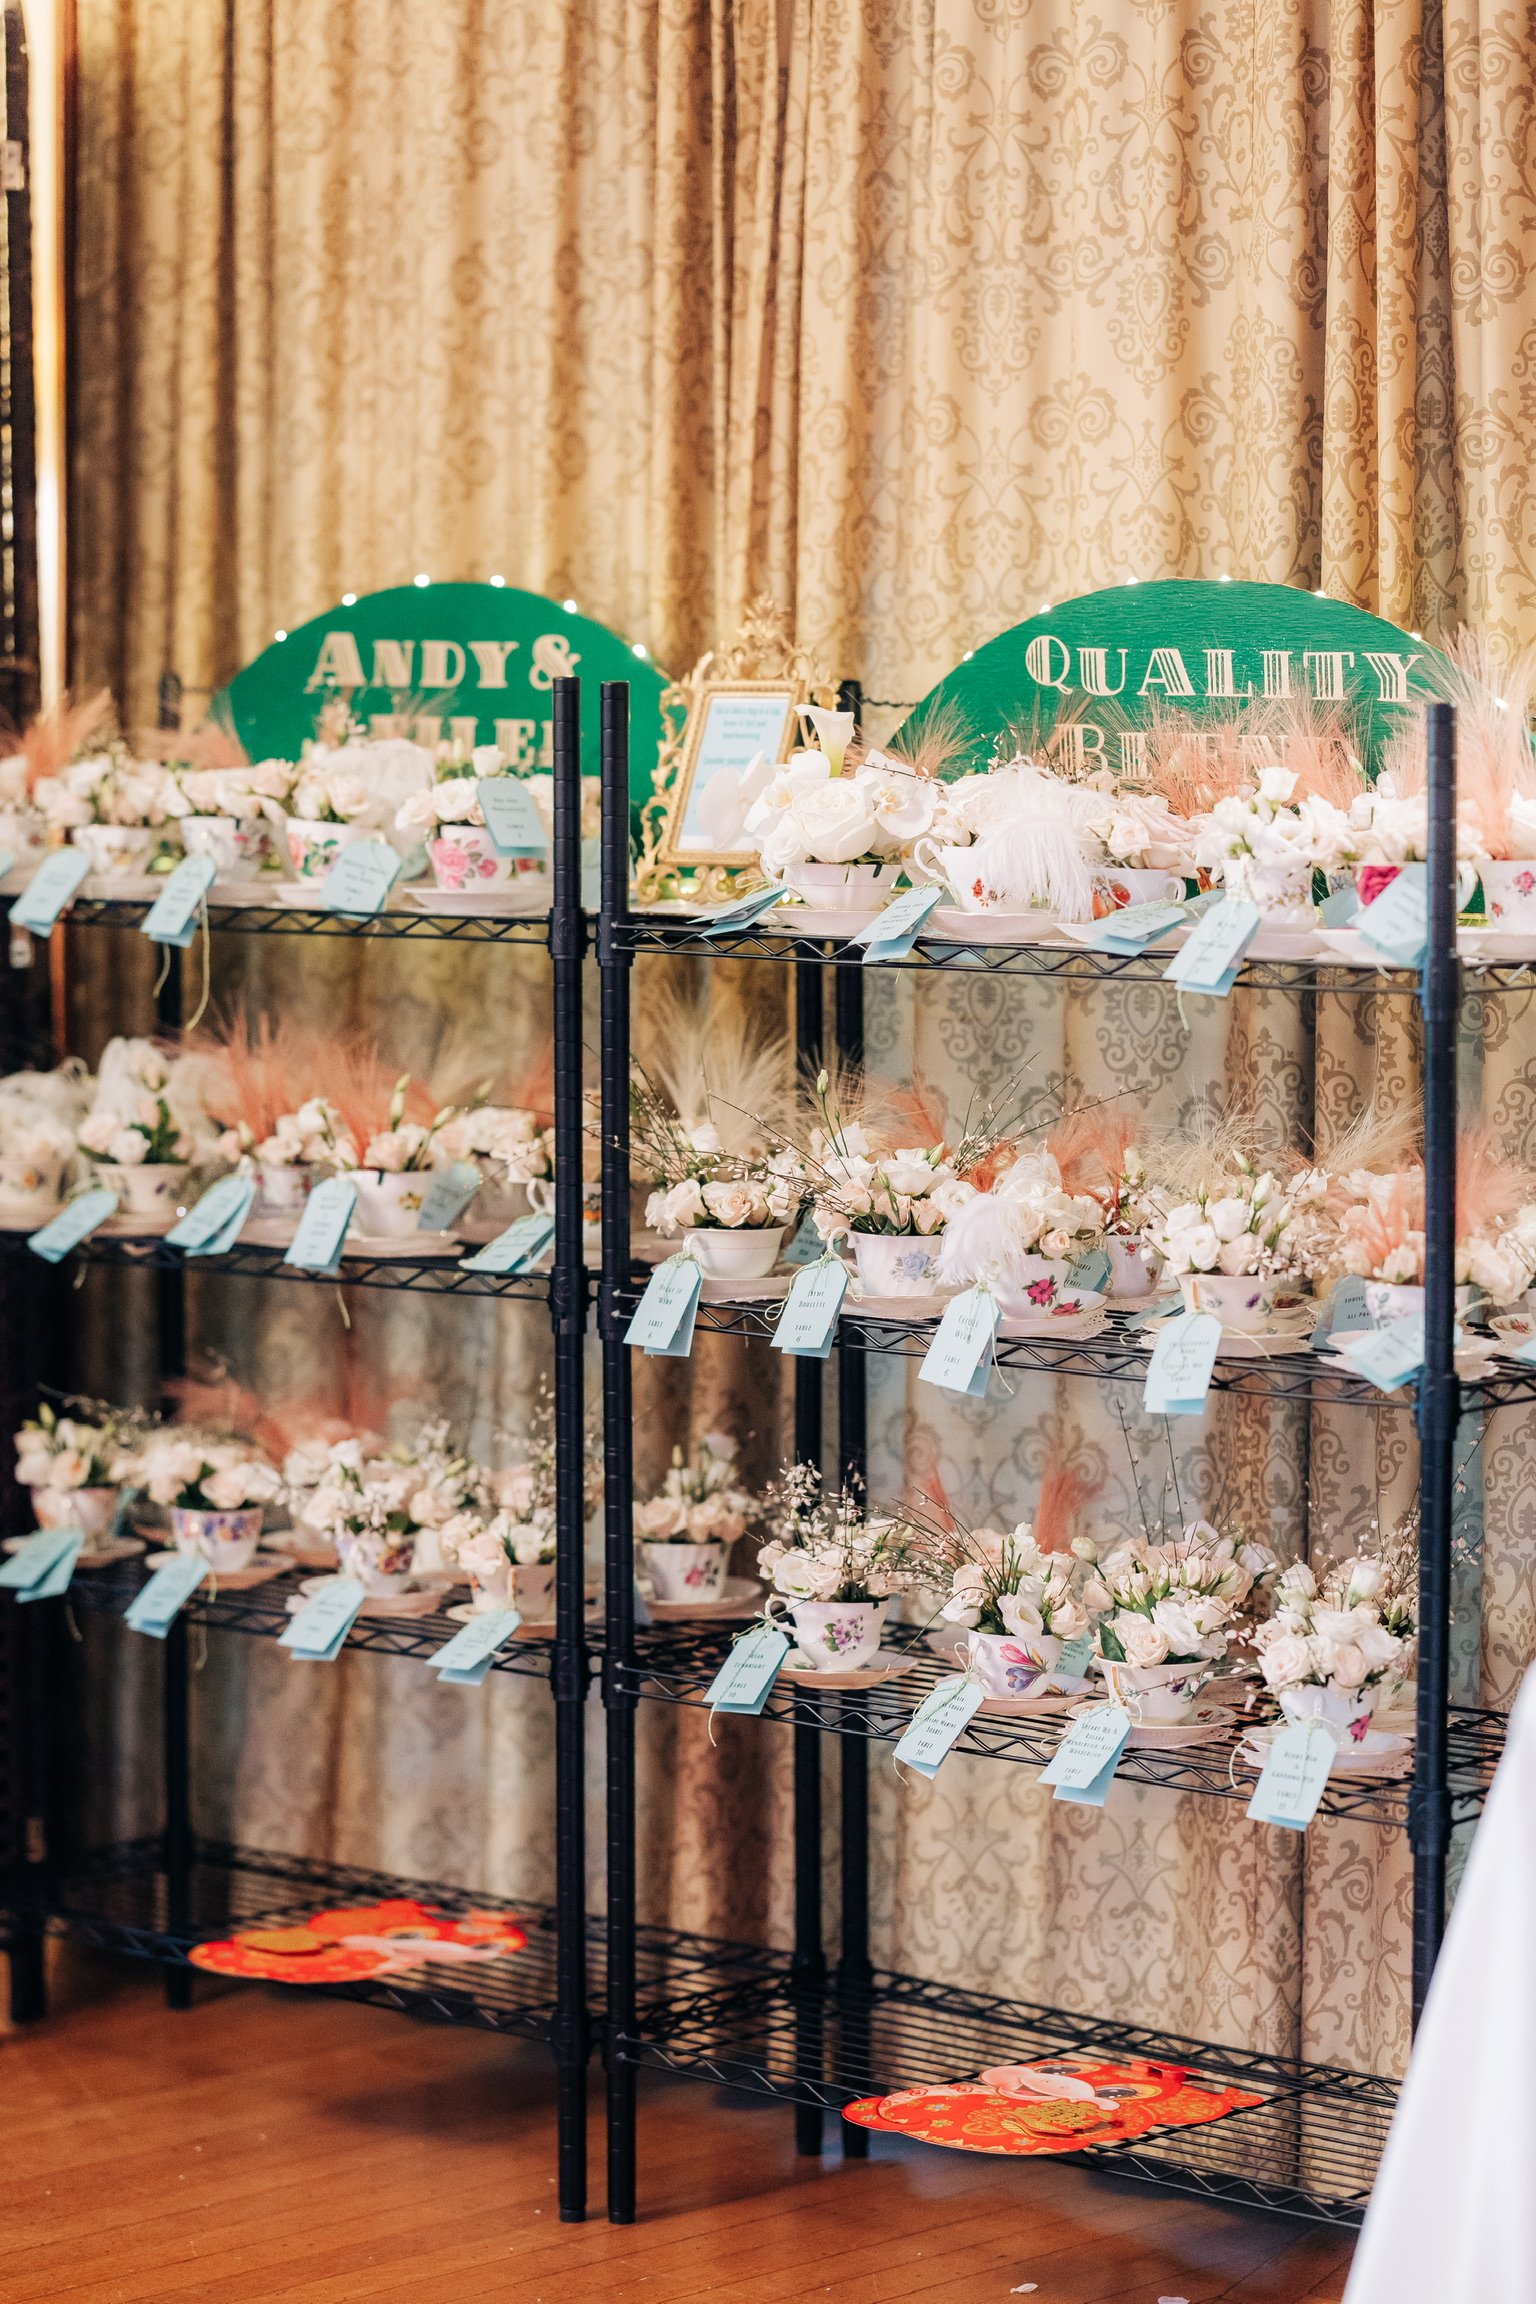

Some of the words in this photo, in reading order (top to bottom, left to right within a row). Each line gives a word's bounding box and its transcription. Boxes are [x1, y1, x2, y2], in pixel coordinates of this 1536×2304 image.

[303, 631, 519, 690] ANDY
[528, 634, 581, 690] &
[1025, 635, 1425, 702] QUALITY
[648, 1320, 663, 1328] TABLE
[944, 1354, 960, 1365] TABLE
[918, 1740, 934, 1749] TABLE
